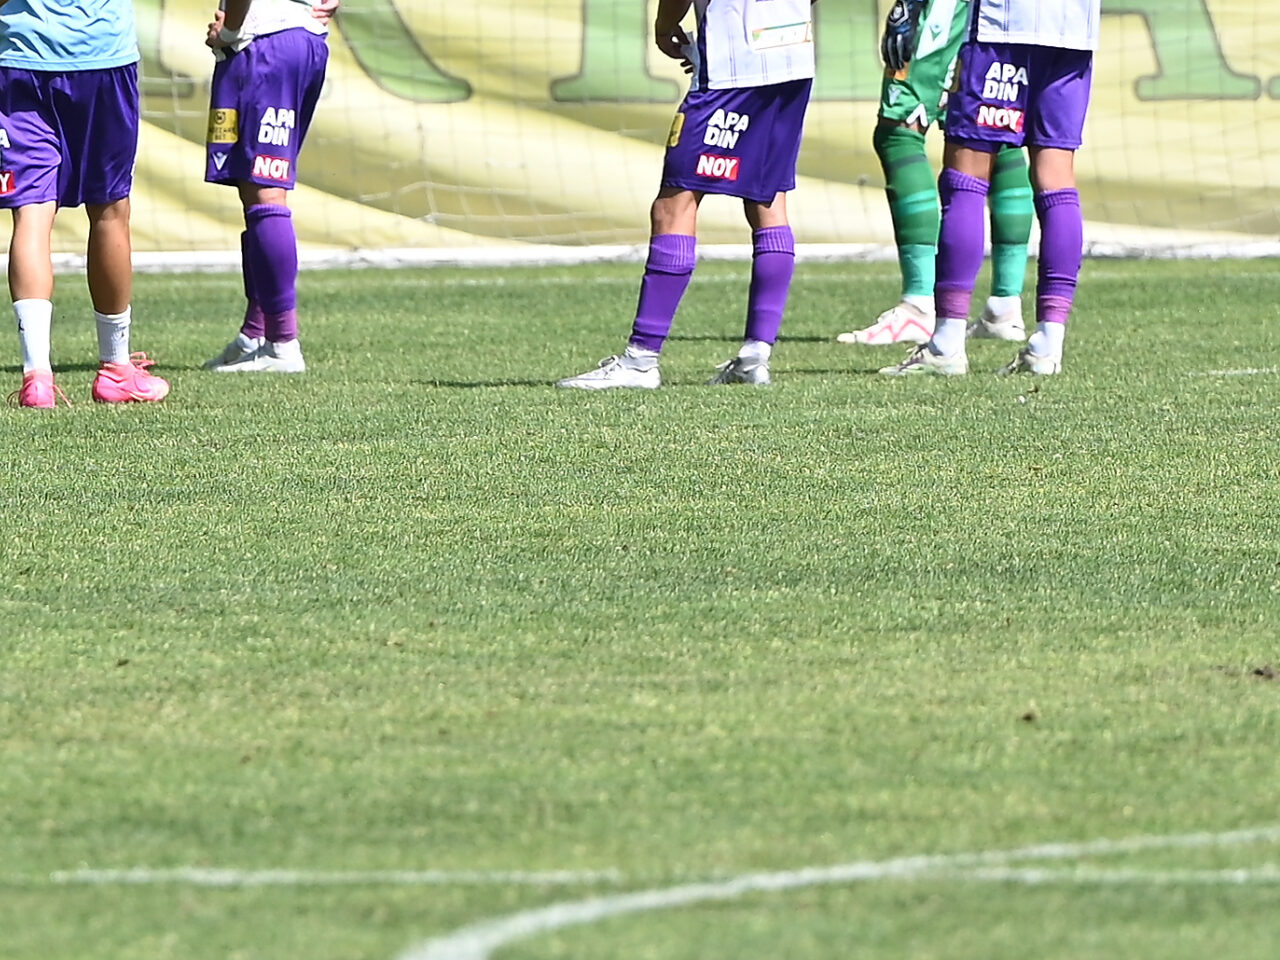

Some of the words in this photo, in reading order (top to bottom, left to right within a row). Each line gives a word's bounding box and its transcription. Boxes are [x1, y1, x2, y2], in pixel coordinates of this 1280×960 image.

[985, 62, 1028, 85] APA
[982, 80, 1019, 102] DIN
[708, 108, 749, 132] APA
[977, 105, 1022, 129] NOY
[258, 125, 289, 147] DIN
[703, 126, 740, 150] DIN
[696, 155, 738, 178] NOY
